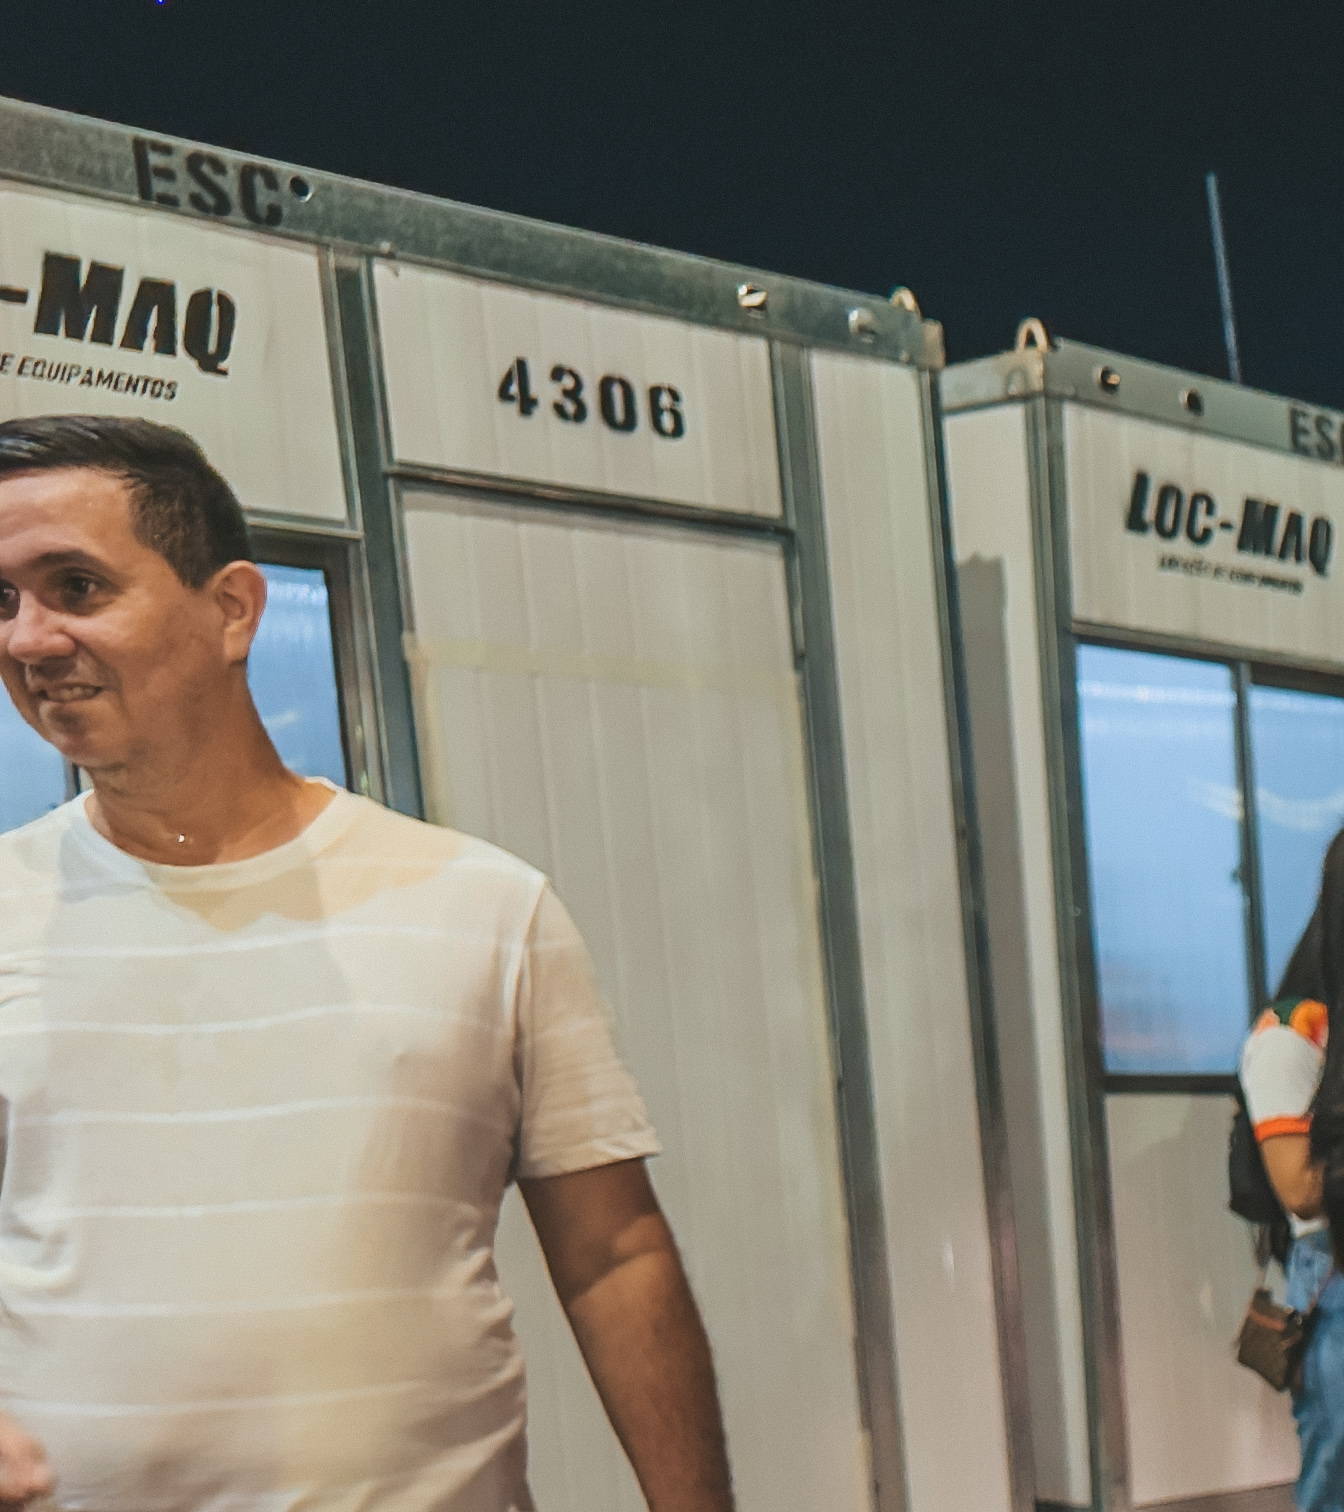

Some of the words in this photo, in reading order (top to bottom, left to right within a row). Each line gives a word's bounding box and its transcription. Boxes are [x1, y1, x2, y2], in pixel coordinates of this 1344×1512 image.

[132, 135, 283, 227] ESC
[17, 354, 179, 401] EQUIPAMENTOS
[498, 356, 685, 438] 4306
[1126, 470, 1333, 579] LOC-MAQ
